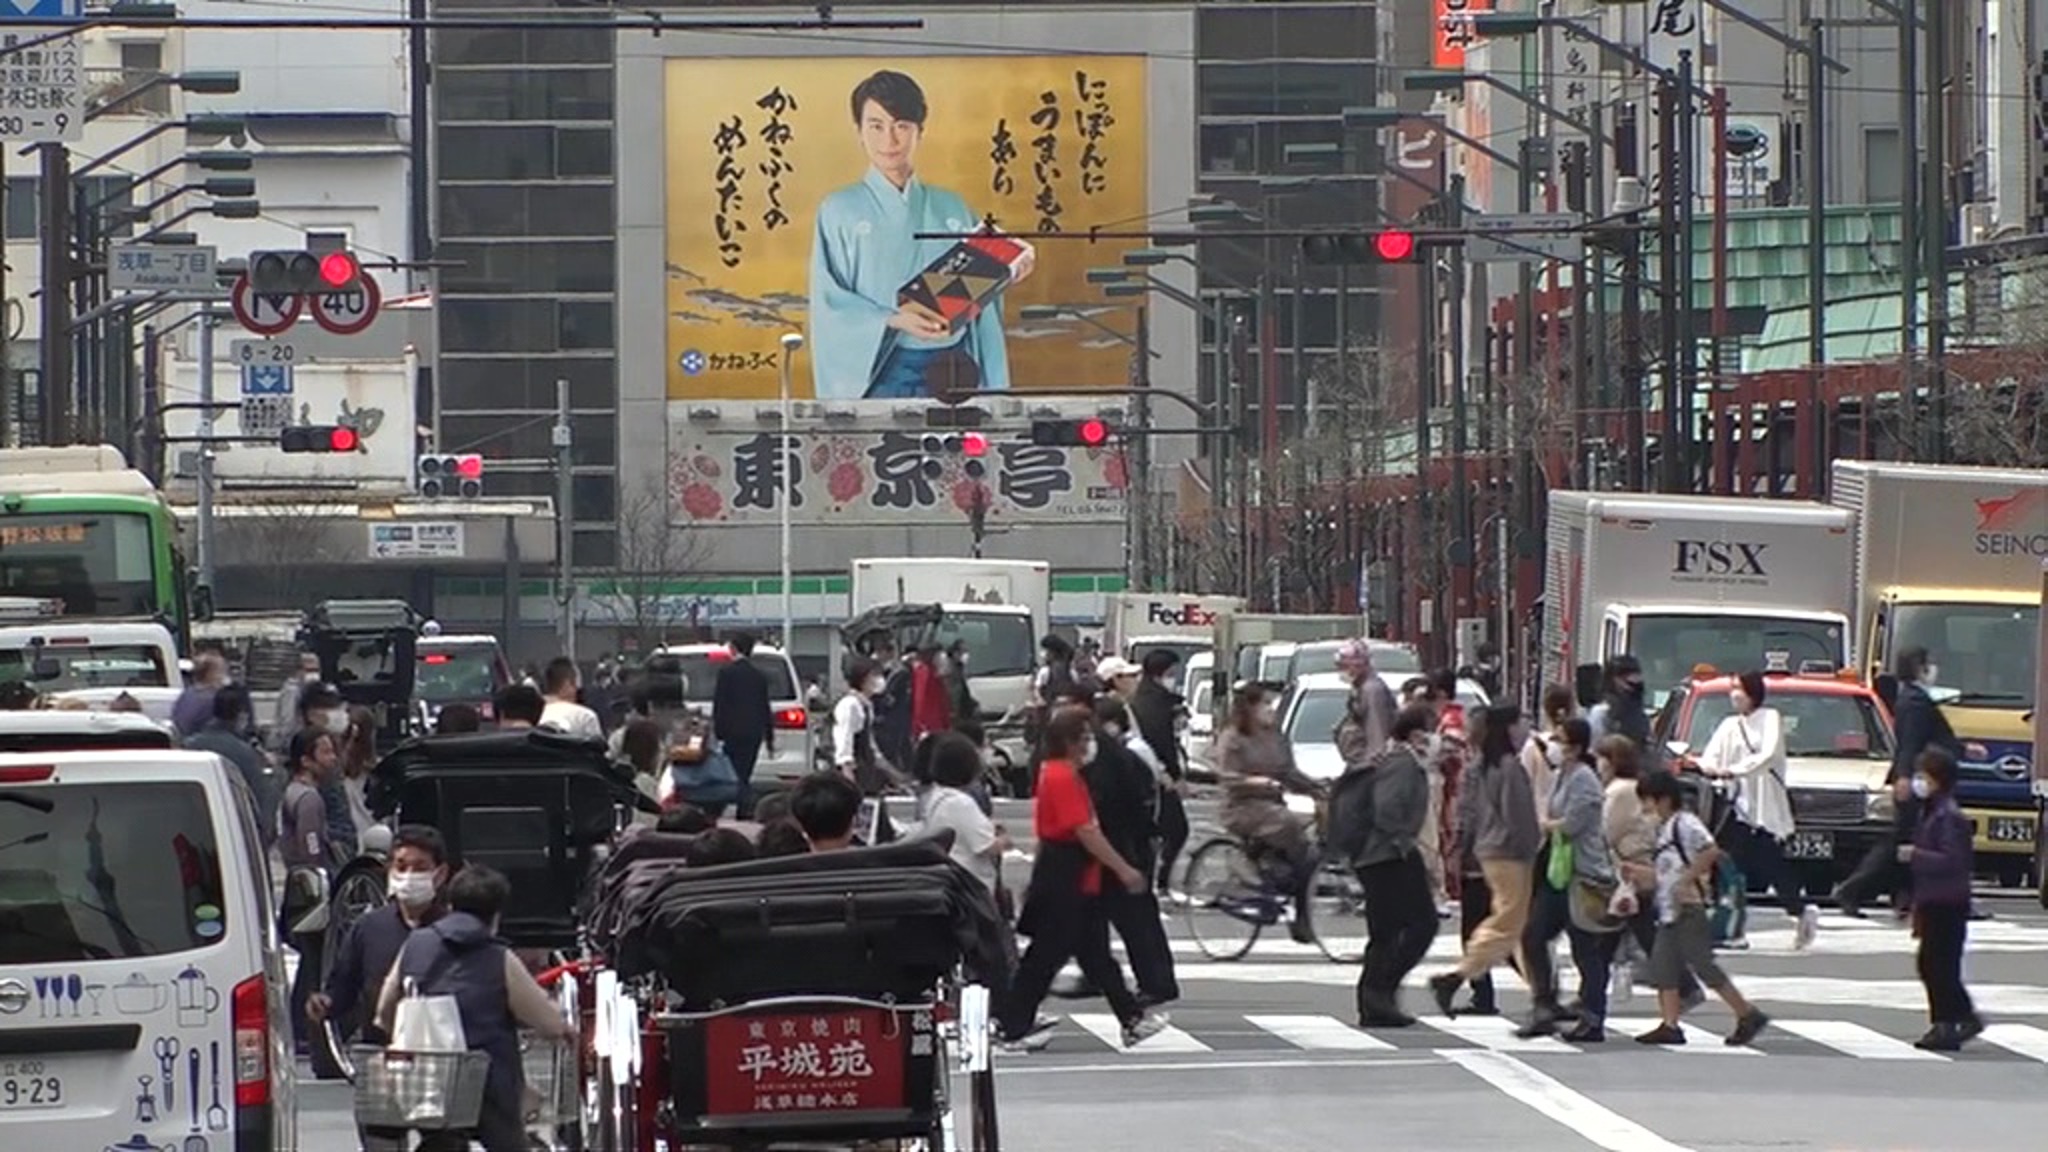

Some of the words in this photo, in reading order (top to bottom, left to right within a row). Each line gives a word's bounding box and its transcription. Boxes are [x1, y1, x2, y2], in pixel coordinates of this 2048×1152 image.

[756, 86, 798, 231] かねふくの
[991, 118, 1017, 195] あり
[1076, 70, 1115, 194] にっぽんに
[713, 114, 747, 268] めんたいこ
[1031, 91, 1063, 233] うまいもの
[117, 251, 207, 273] 浅草一丁目
[709, 351, 778, 371] かねふく
[733, 431, 1073, 508] 東京亭
[1672, 540, 1769, 576] FSX
[1148, 602, 1216, 625] FedEx
[738, 1040, 873, 1081] 平城苑
[4, 1077, 61, 1105] 9-29
